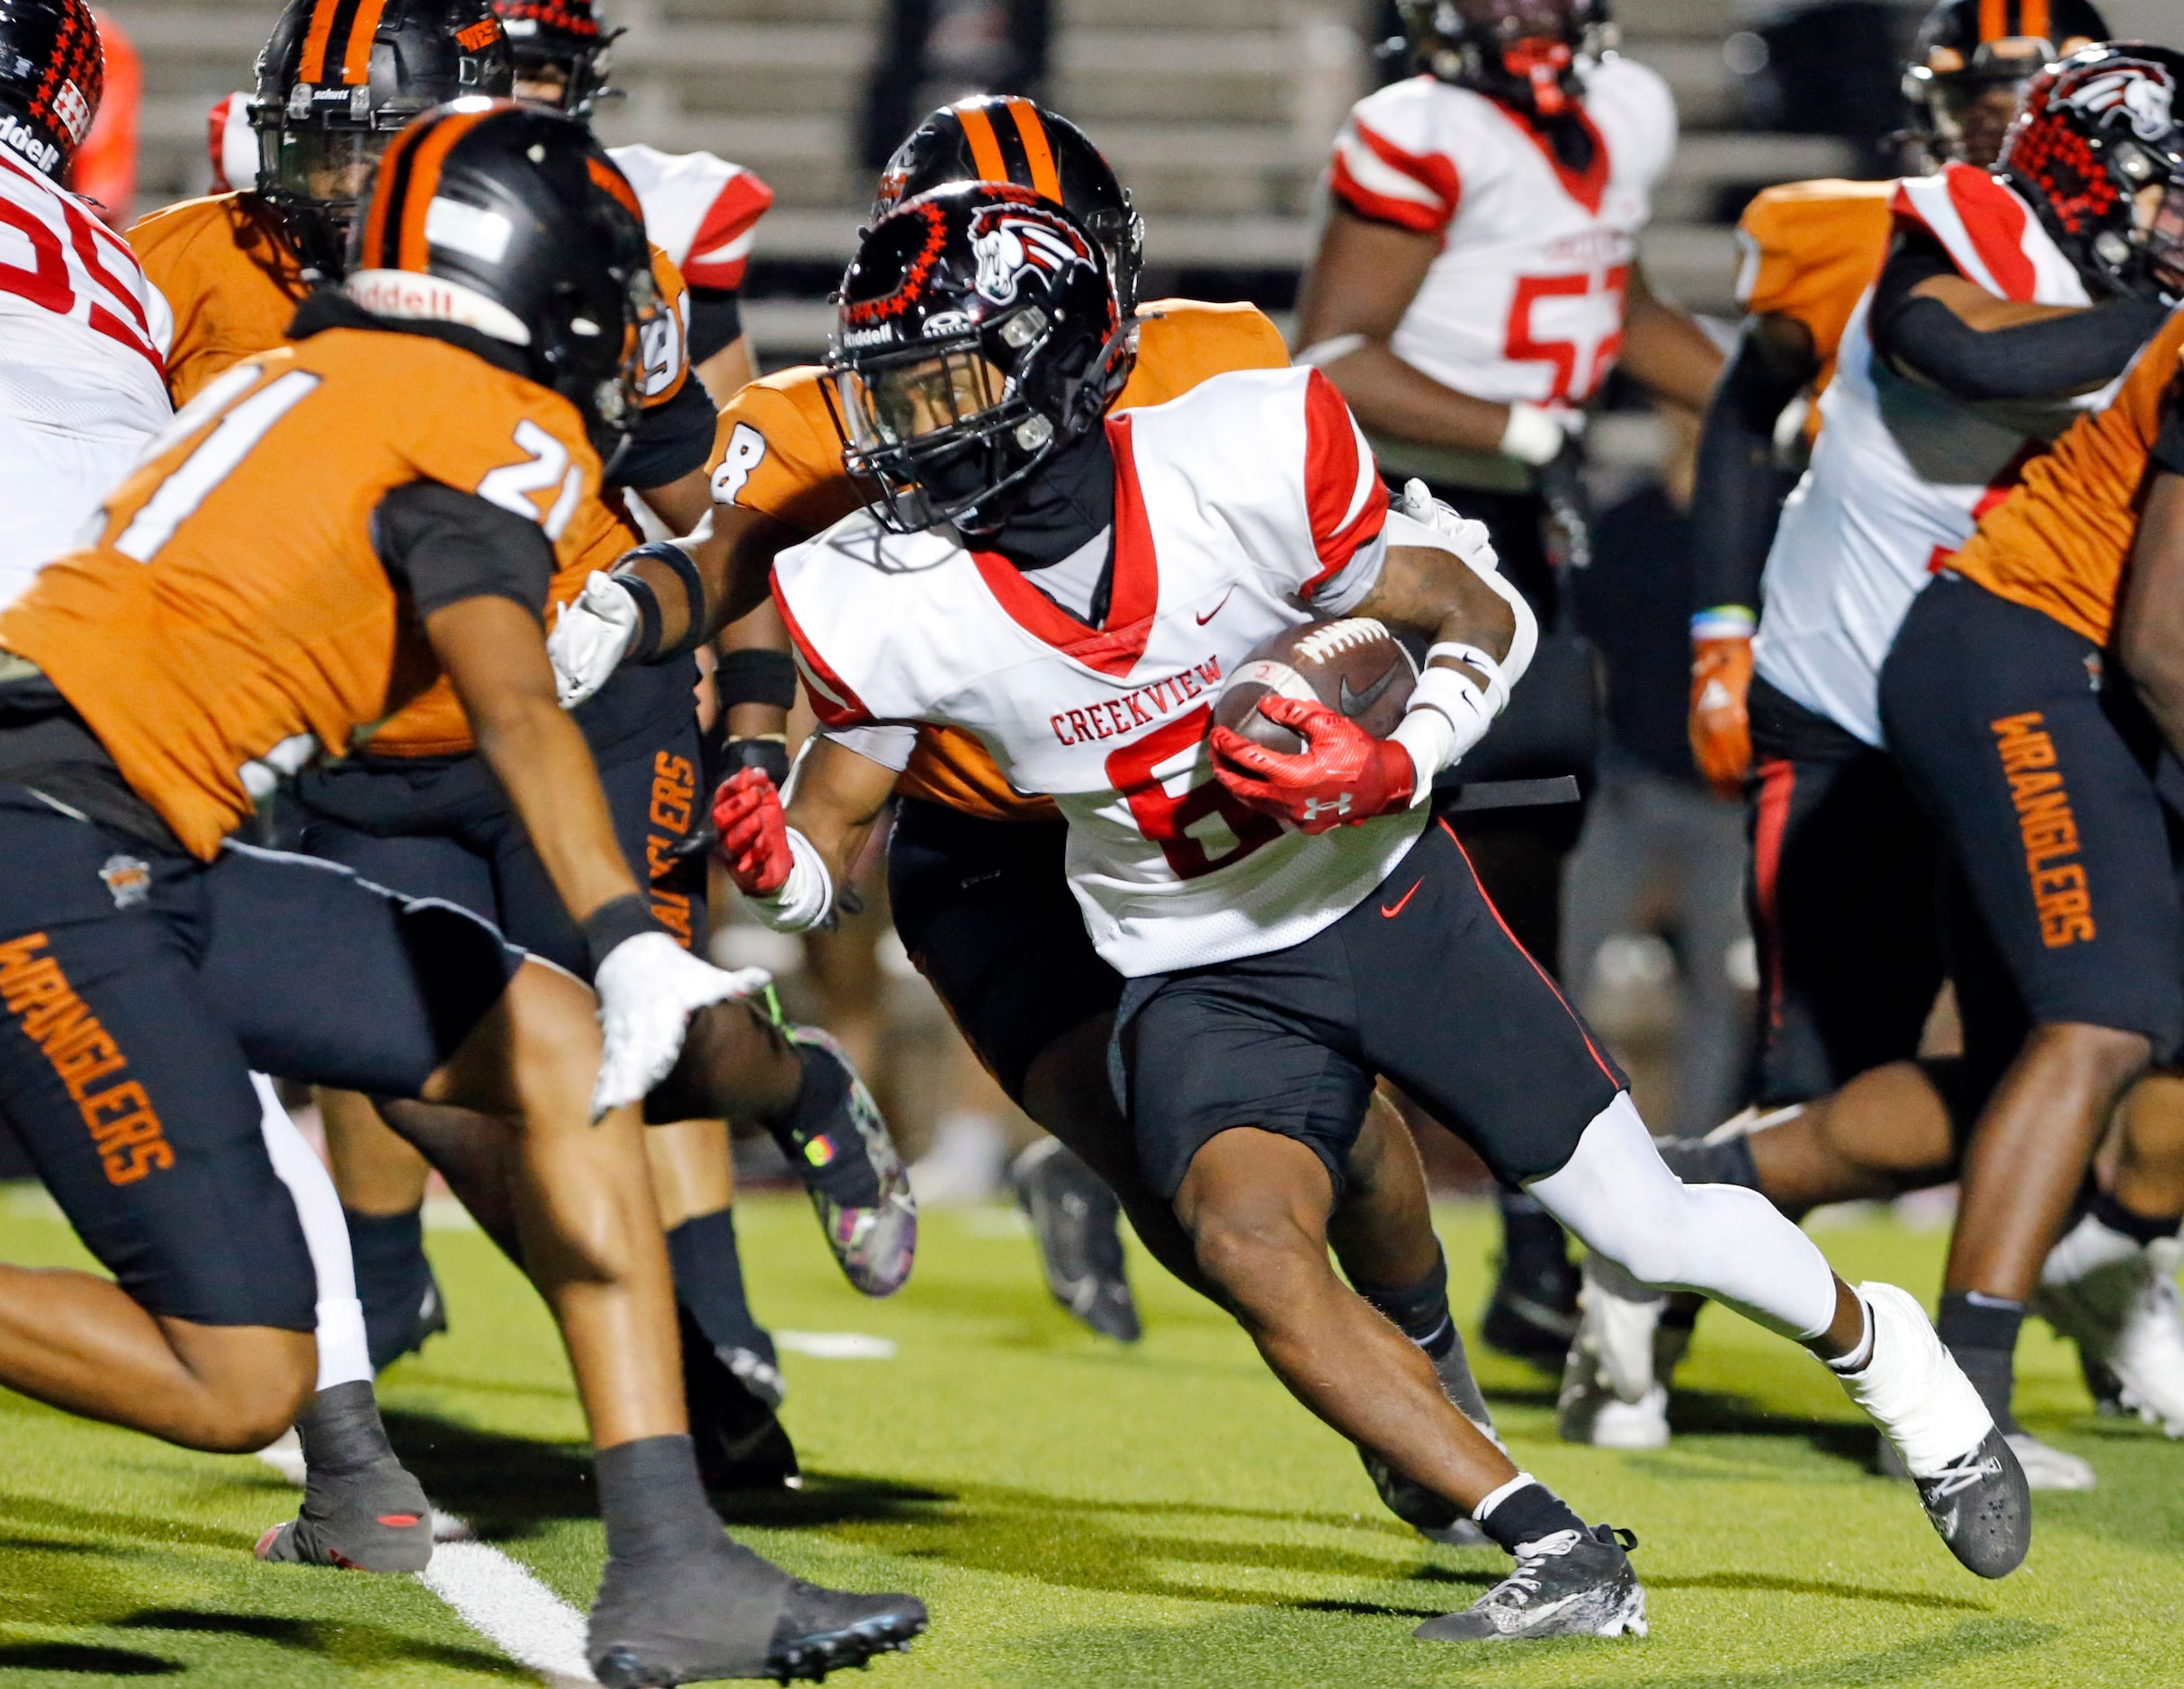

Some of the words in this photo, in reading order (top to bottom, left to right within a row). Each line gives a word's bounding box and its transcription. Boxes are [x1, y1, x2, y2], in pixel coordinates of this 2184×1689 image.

[843, 321, 892, 349] Riddell
[476, 418, 583, 542] 21
[710, 420, 766, 506] 8
[1049, 654, 1222, 746] CREEKVIEW
[1104, 700, 1284, 880] 6
[1990, 710, 2097, 949] WRANGLERS
[0, 931, 175, 1186] WRANGLERS
